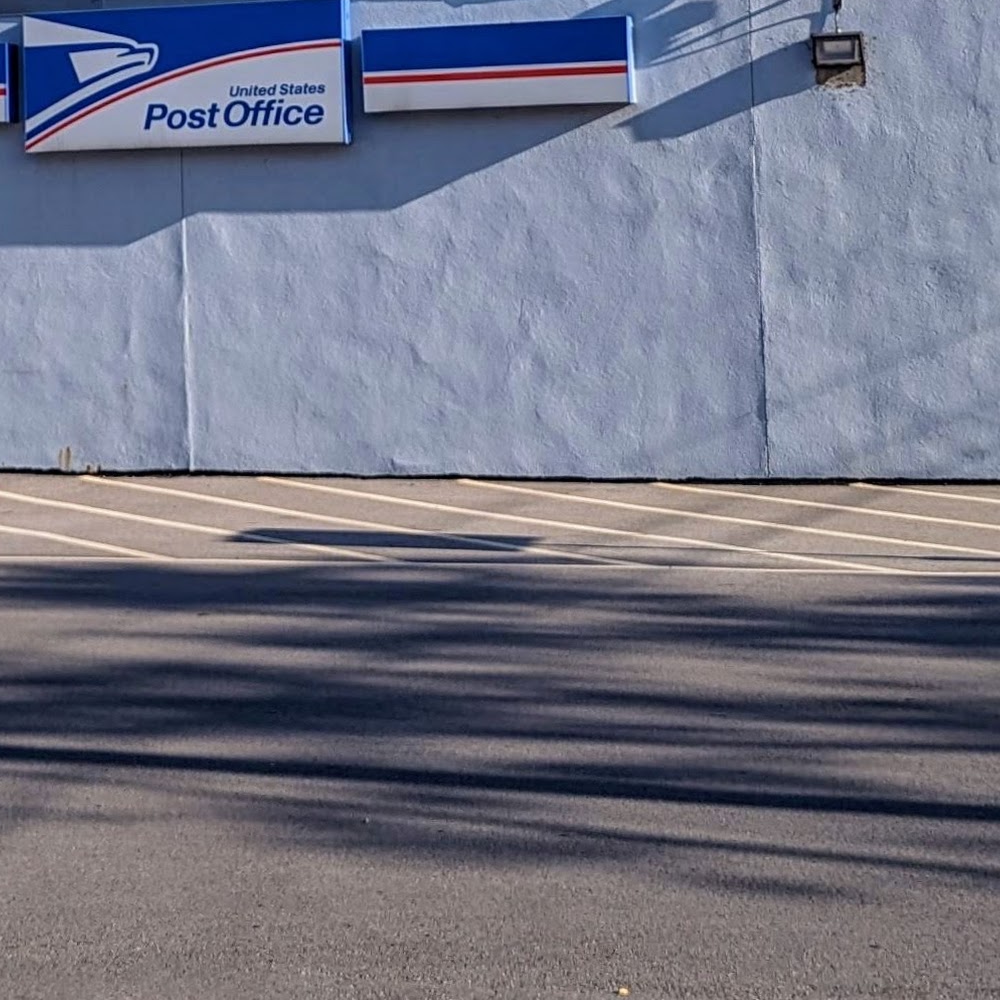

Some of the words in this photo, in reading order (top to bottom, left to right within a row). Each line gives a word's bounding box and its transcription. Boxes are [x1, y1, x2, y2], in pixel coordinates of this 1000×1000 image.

[229, 84, 276, 98] United
[279, 83, 326, 96] States
[144, 103, 220, 130] Post
[223, 99, 325, 127] Office
